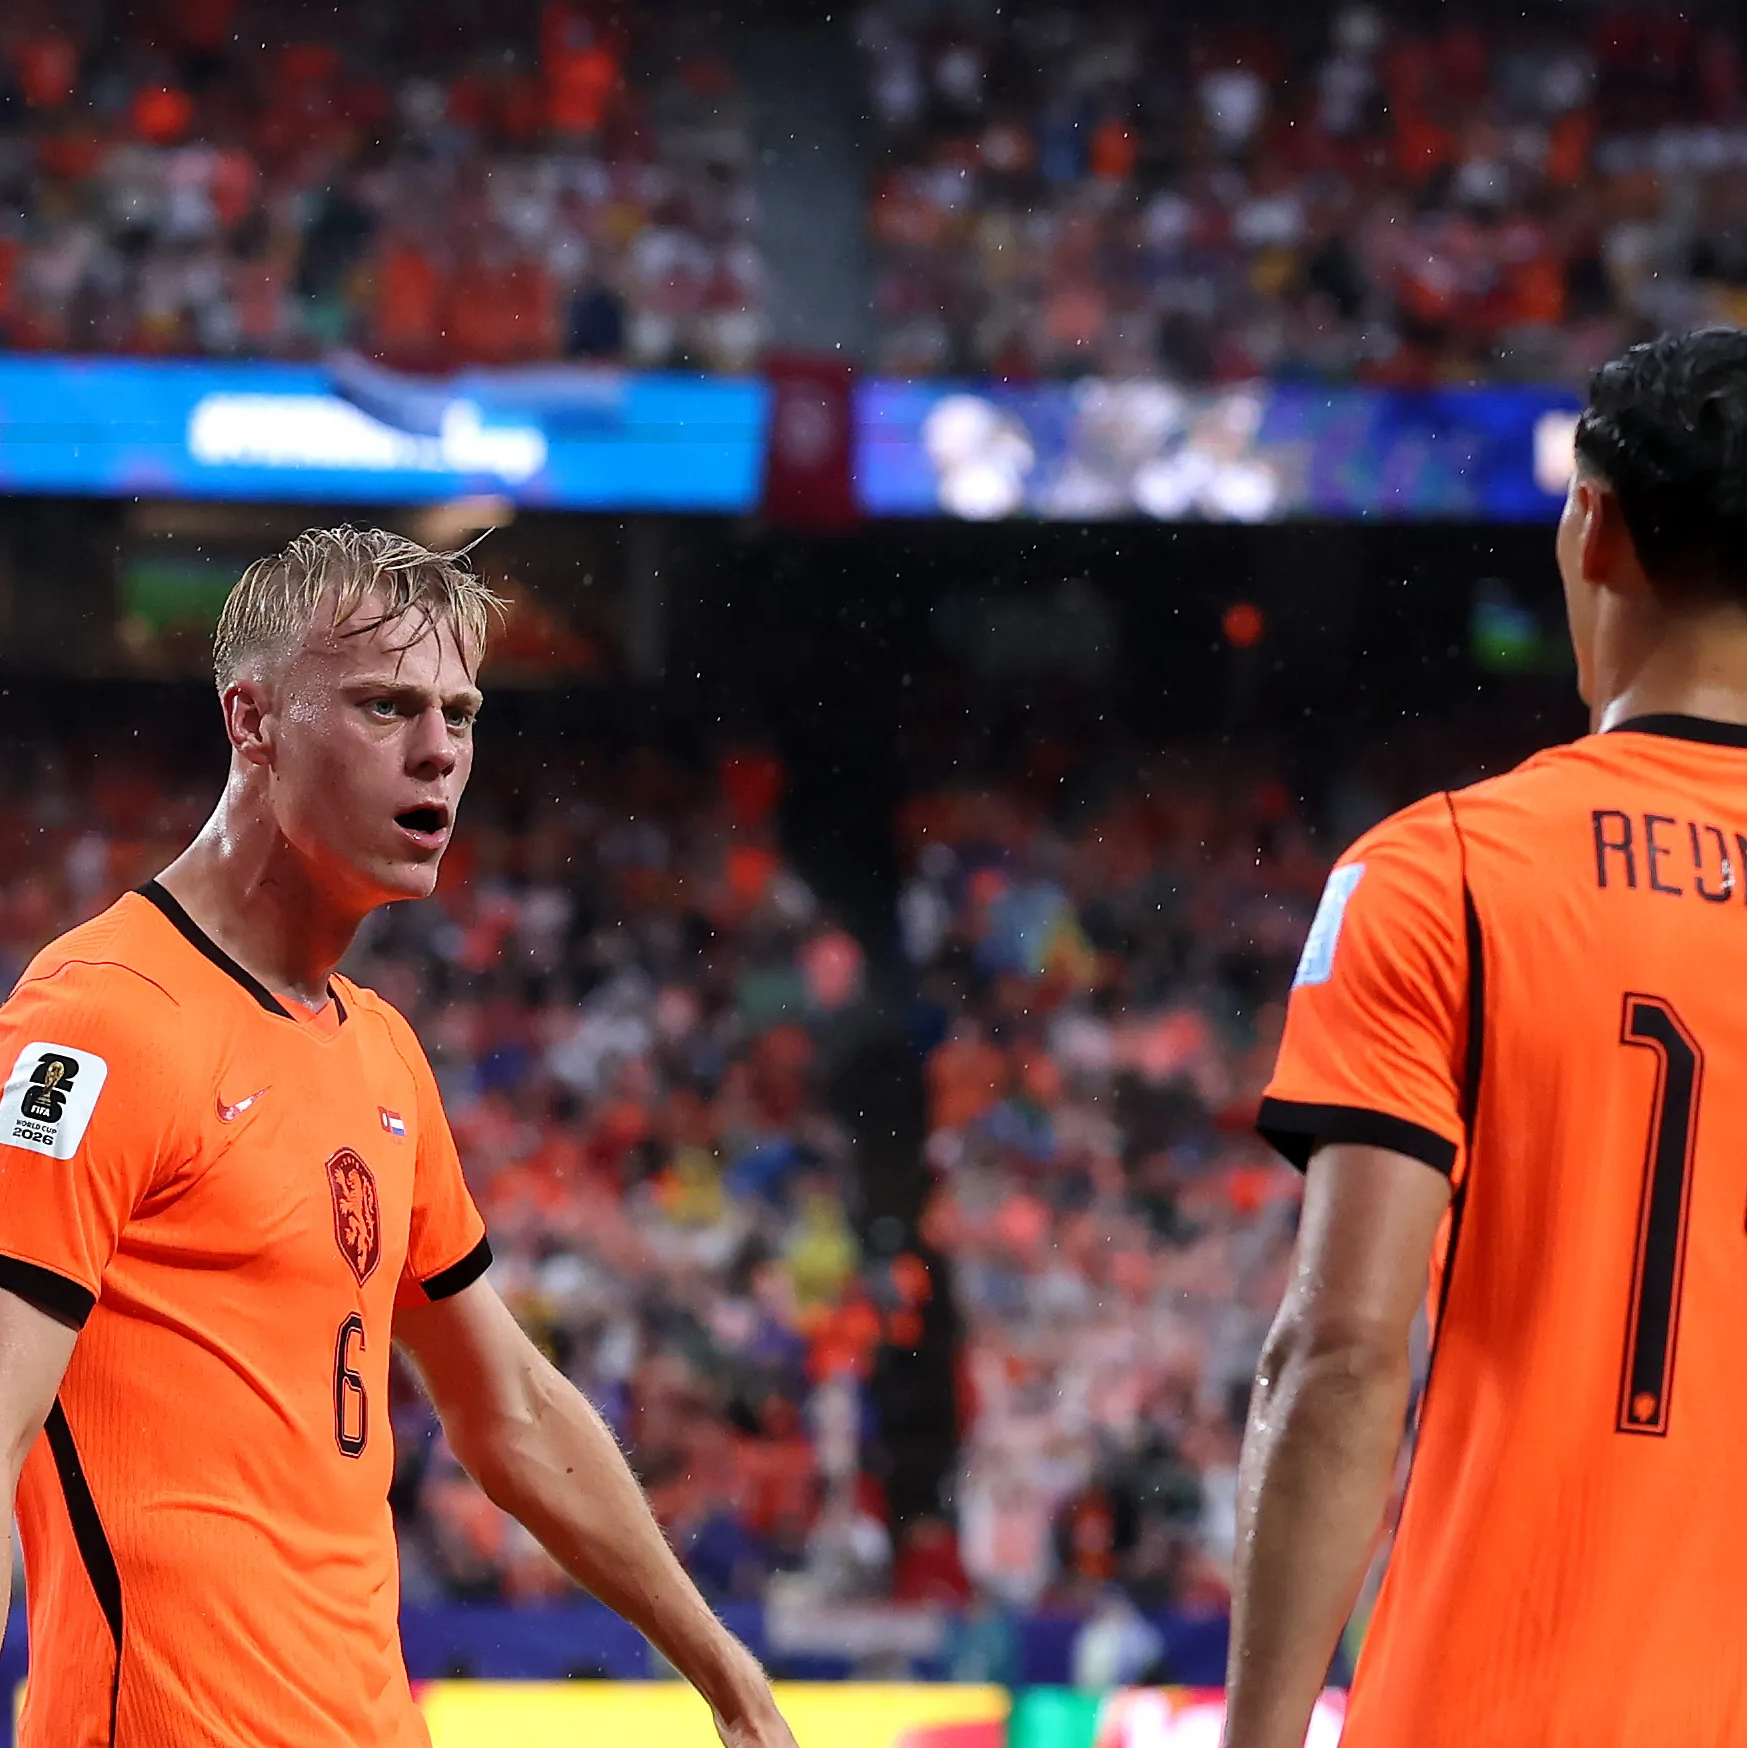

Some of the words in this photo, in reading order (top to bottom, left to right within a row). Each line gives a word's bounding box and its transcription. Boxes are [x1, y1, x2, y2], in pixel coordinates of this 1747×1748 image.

[30, 1105, 51, 1118] FIFA
[15, 1119, 41, 1131] WORLD
[41, 1125, 58, 1135] CUP
[12, 1127, 54, 1146] 2026
[333, 1310, 369, 1460] 6
